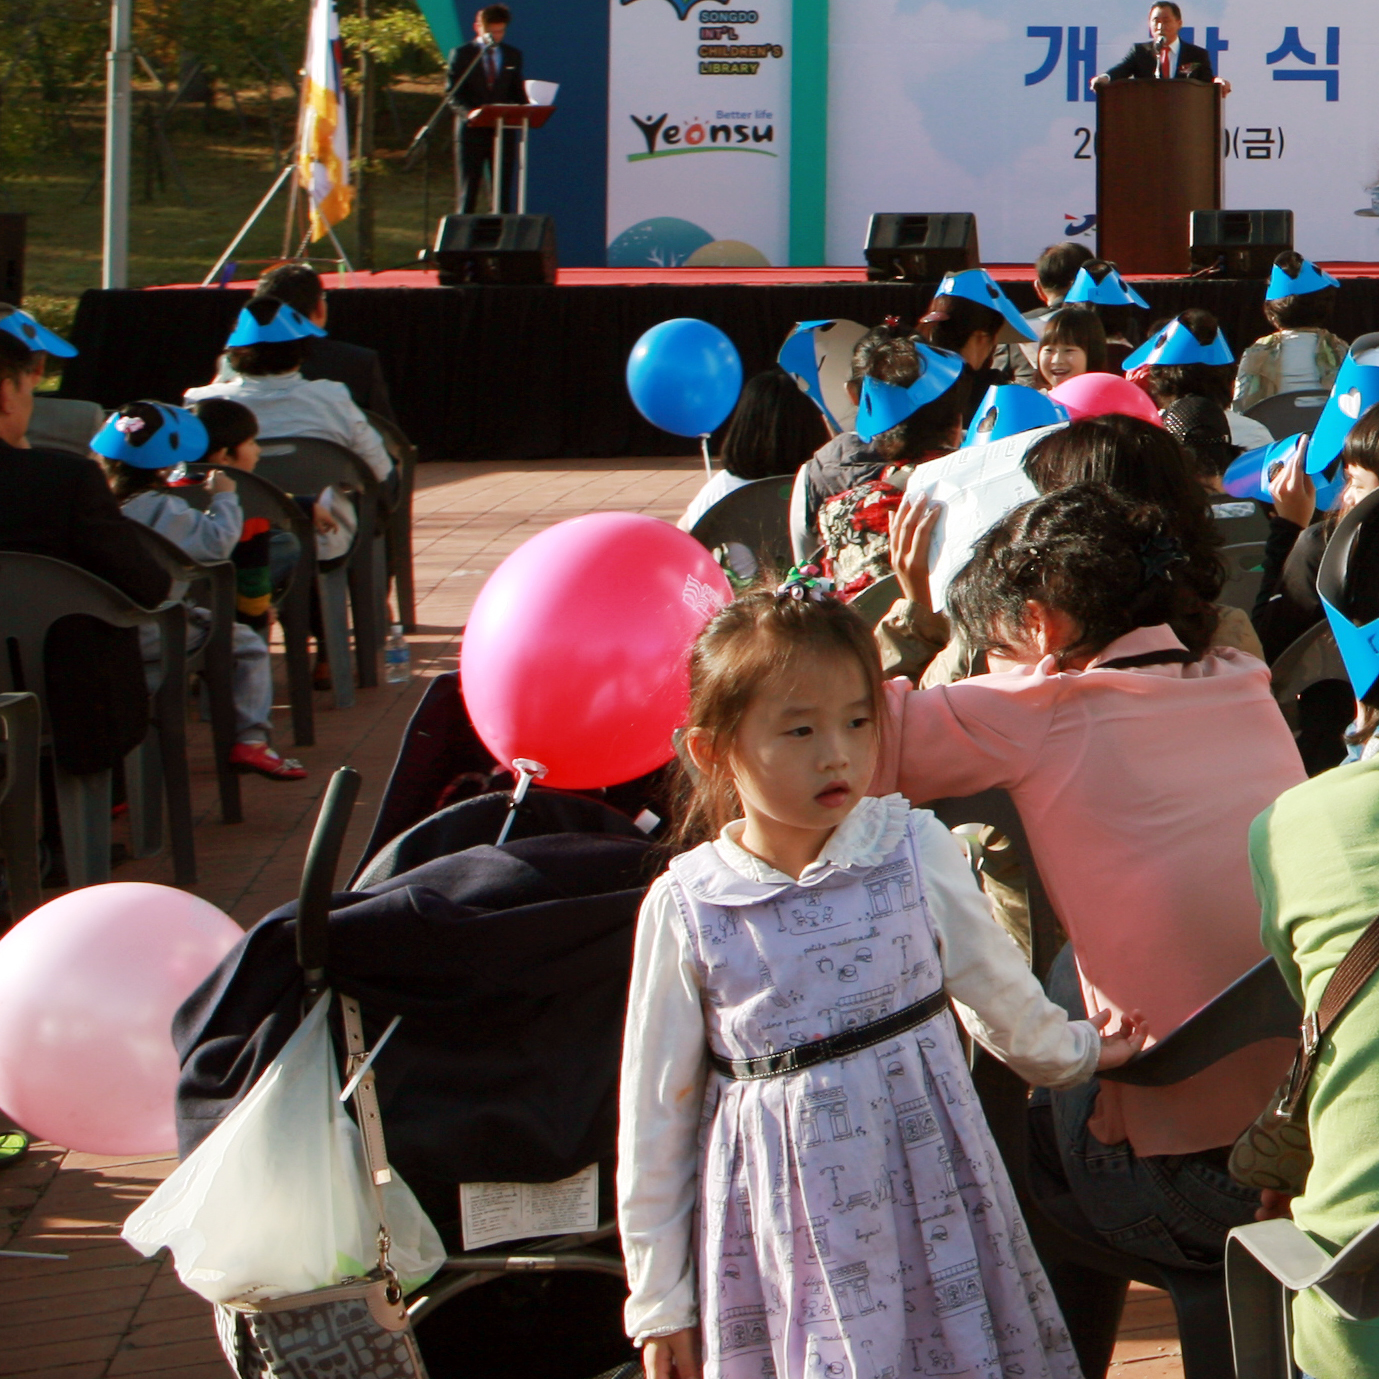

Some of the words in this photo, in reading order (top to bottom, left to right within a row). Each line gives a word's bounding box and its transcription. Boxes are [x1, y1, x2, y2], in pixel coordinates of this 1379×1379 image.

[701, 11, 759, 23] SONGDO
[701, 27, 738, 40] INT'L
[699, 44, 782, 58] CHILDREN'S
[700, 63, 759, 74] LIBRARY
[716, 110, 751, 120] Better
[755, 110, 773, 120] life
[630, 113, 774, 155] Yeonsu
